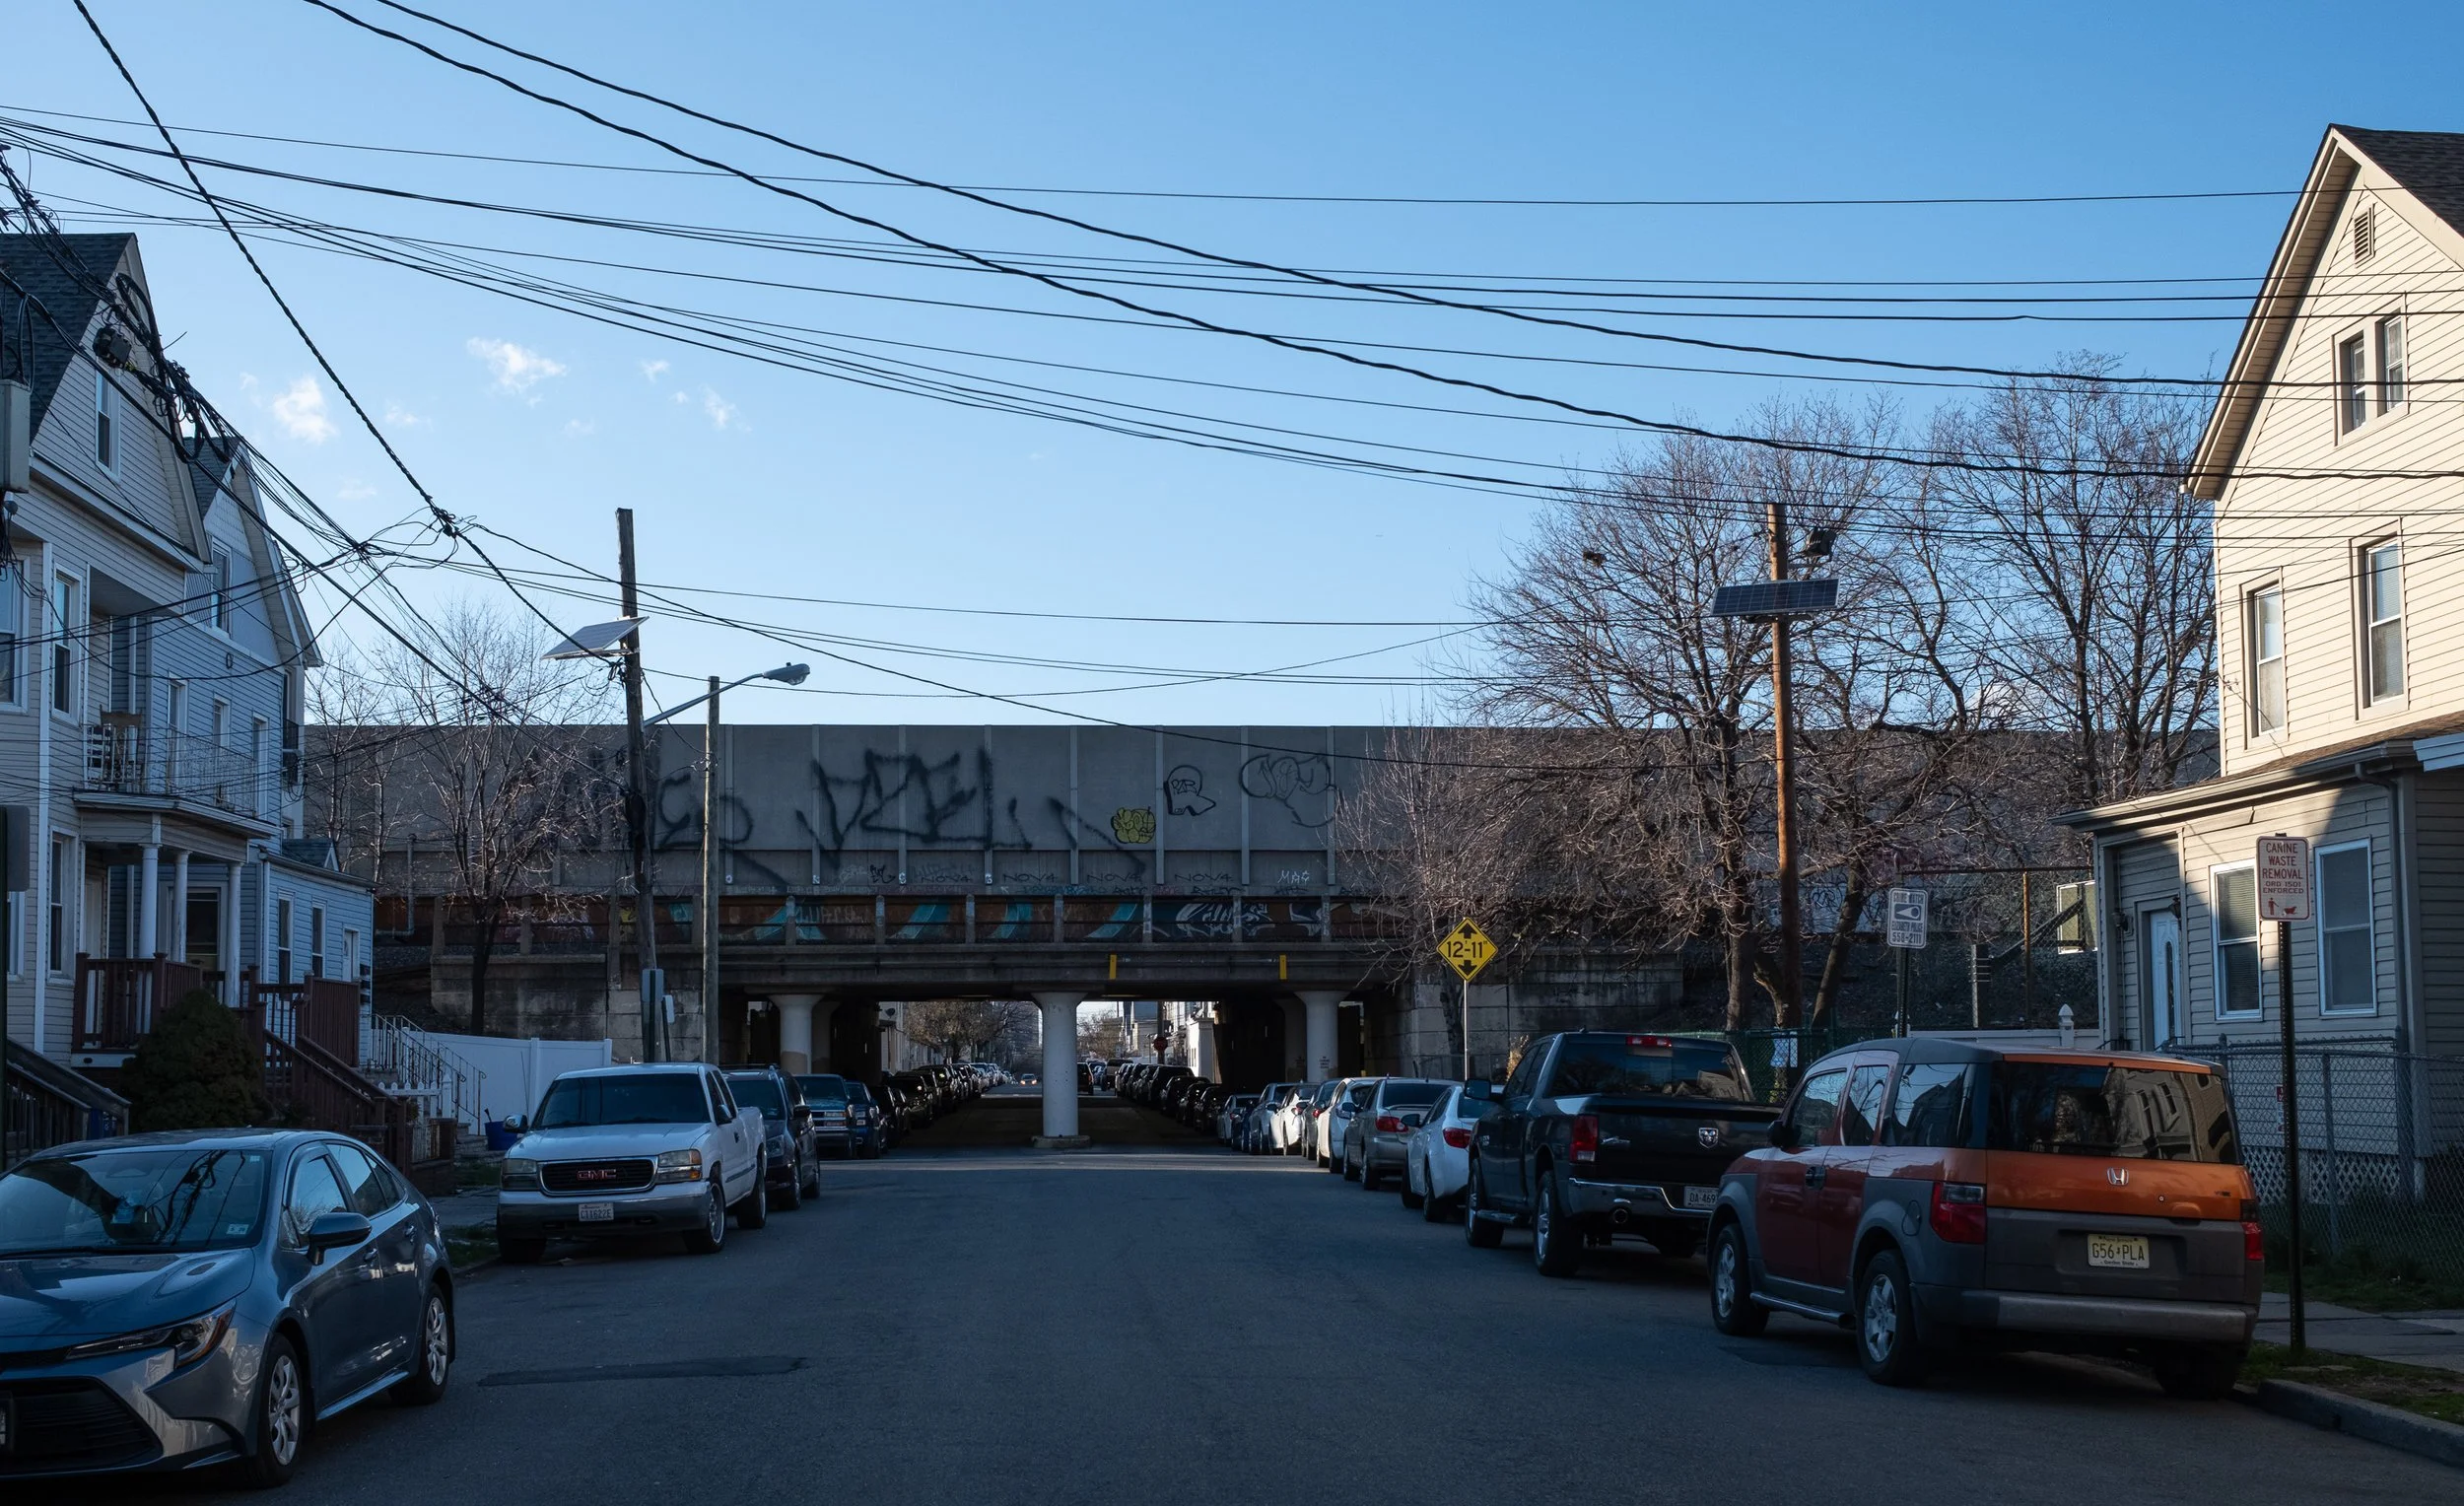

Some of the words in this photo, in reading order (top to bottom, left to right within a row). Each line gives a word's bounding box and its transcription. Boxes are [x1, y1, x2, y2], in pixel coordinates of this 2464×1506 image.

[2266, 843, 2297, 853] CANINE
[2269, 856, 2296, 865] WASTE
[2262, 868, 2303, 879] REMOVAL
[577, 1169, 617, 1180] GMC
